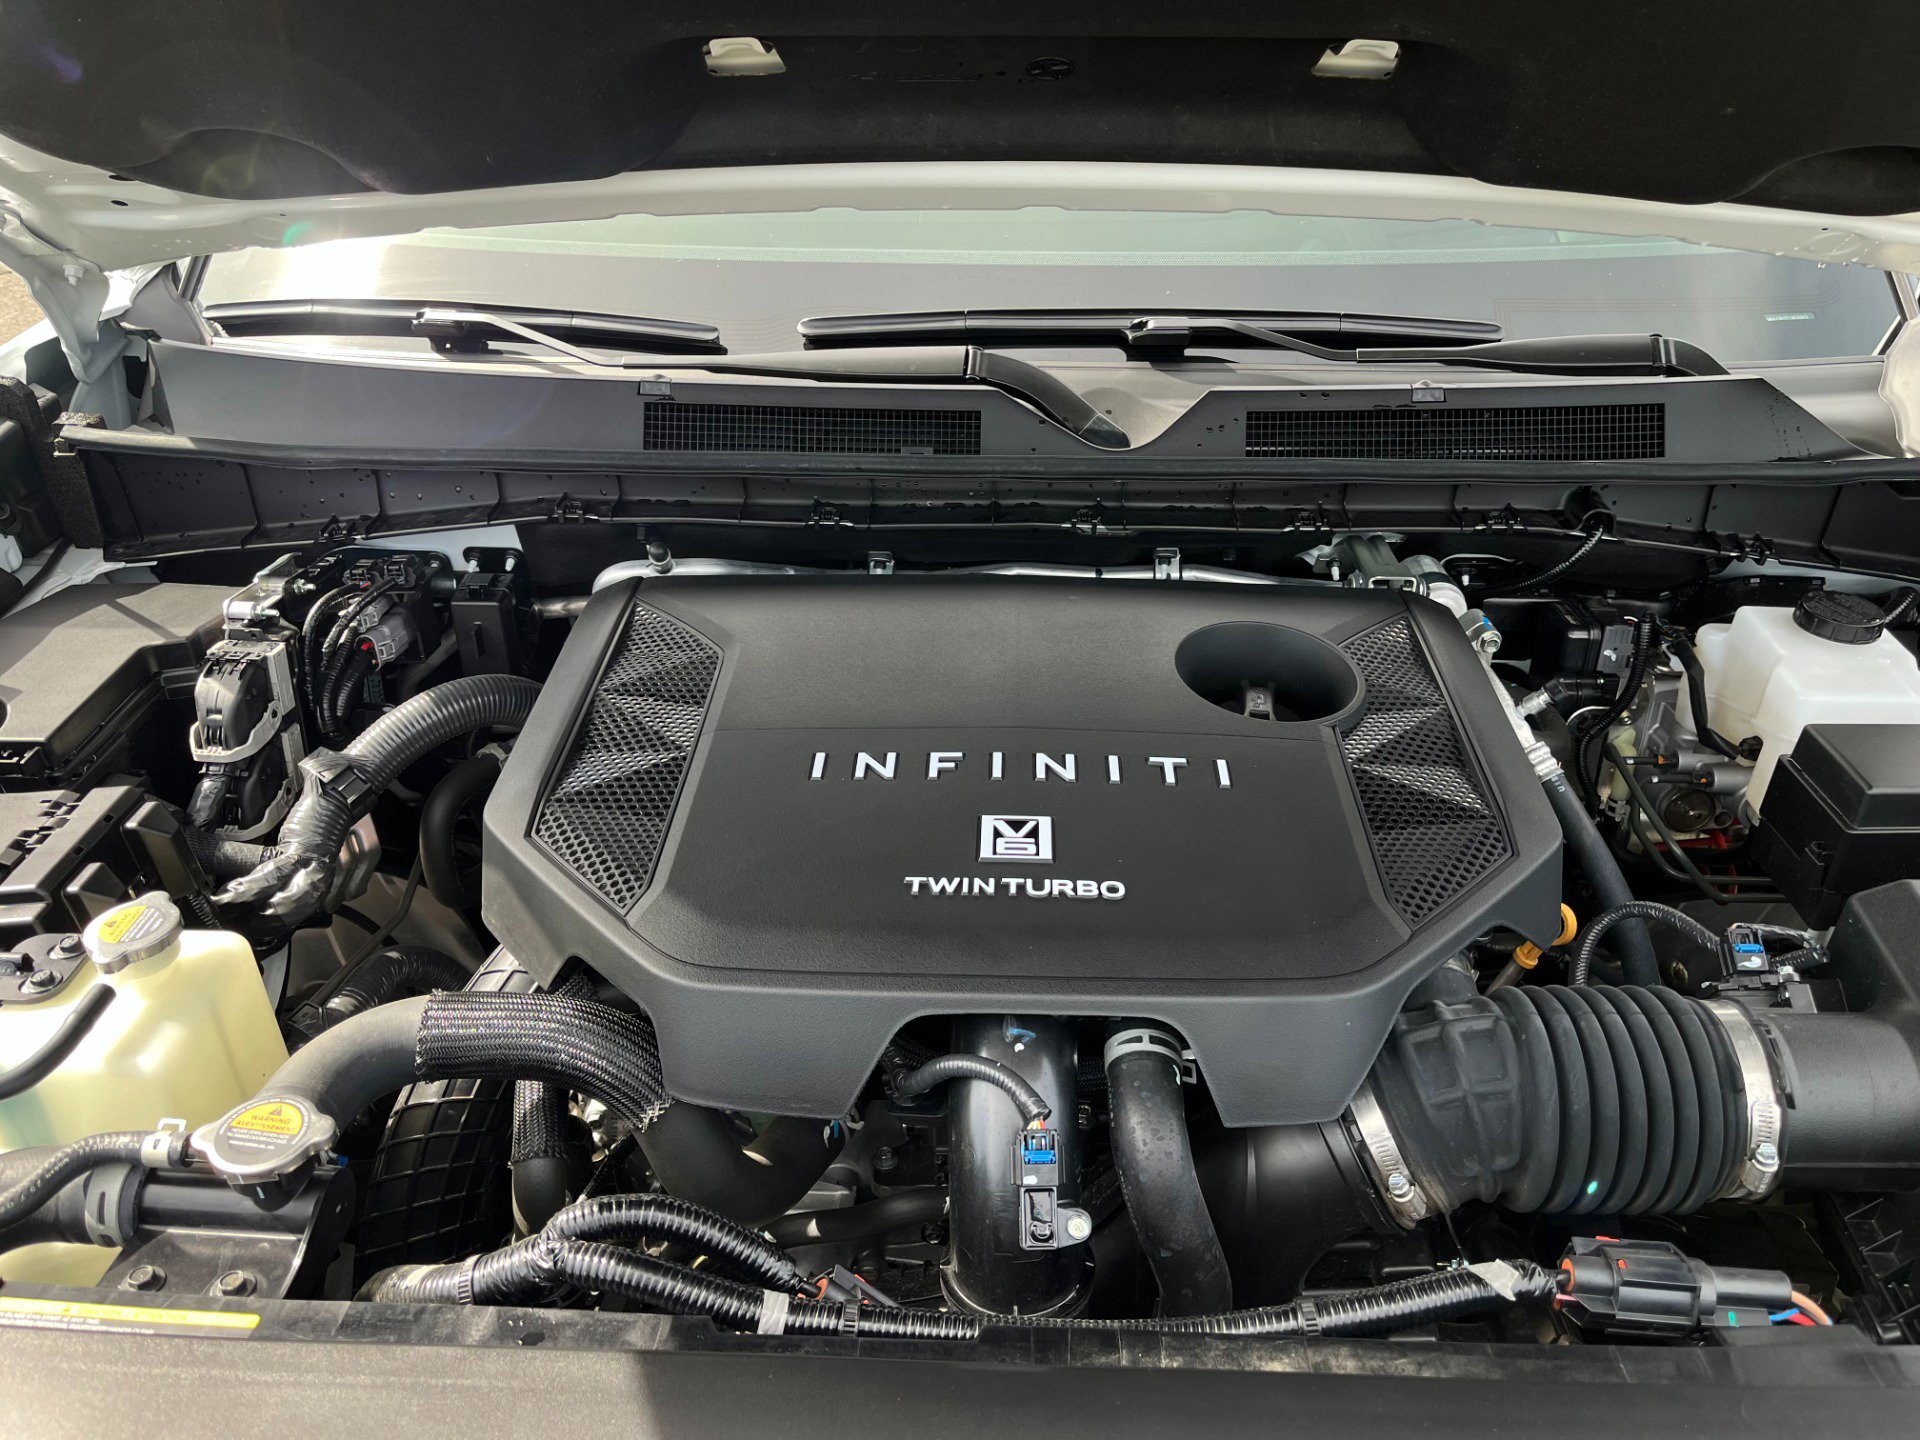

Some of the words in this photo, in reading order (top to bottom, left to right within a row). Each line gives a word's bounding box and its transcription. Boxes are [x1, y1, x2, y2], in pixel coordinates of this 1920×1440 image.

[809, 751, 1232, 789] INFINITI
[904, 876, 995, 896] TWIN
[1001, 877, 1126, 900] TURBO
[250, 1114, 292, 1126] WARNING
